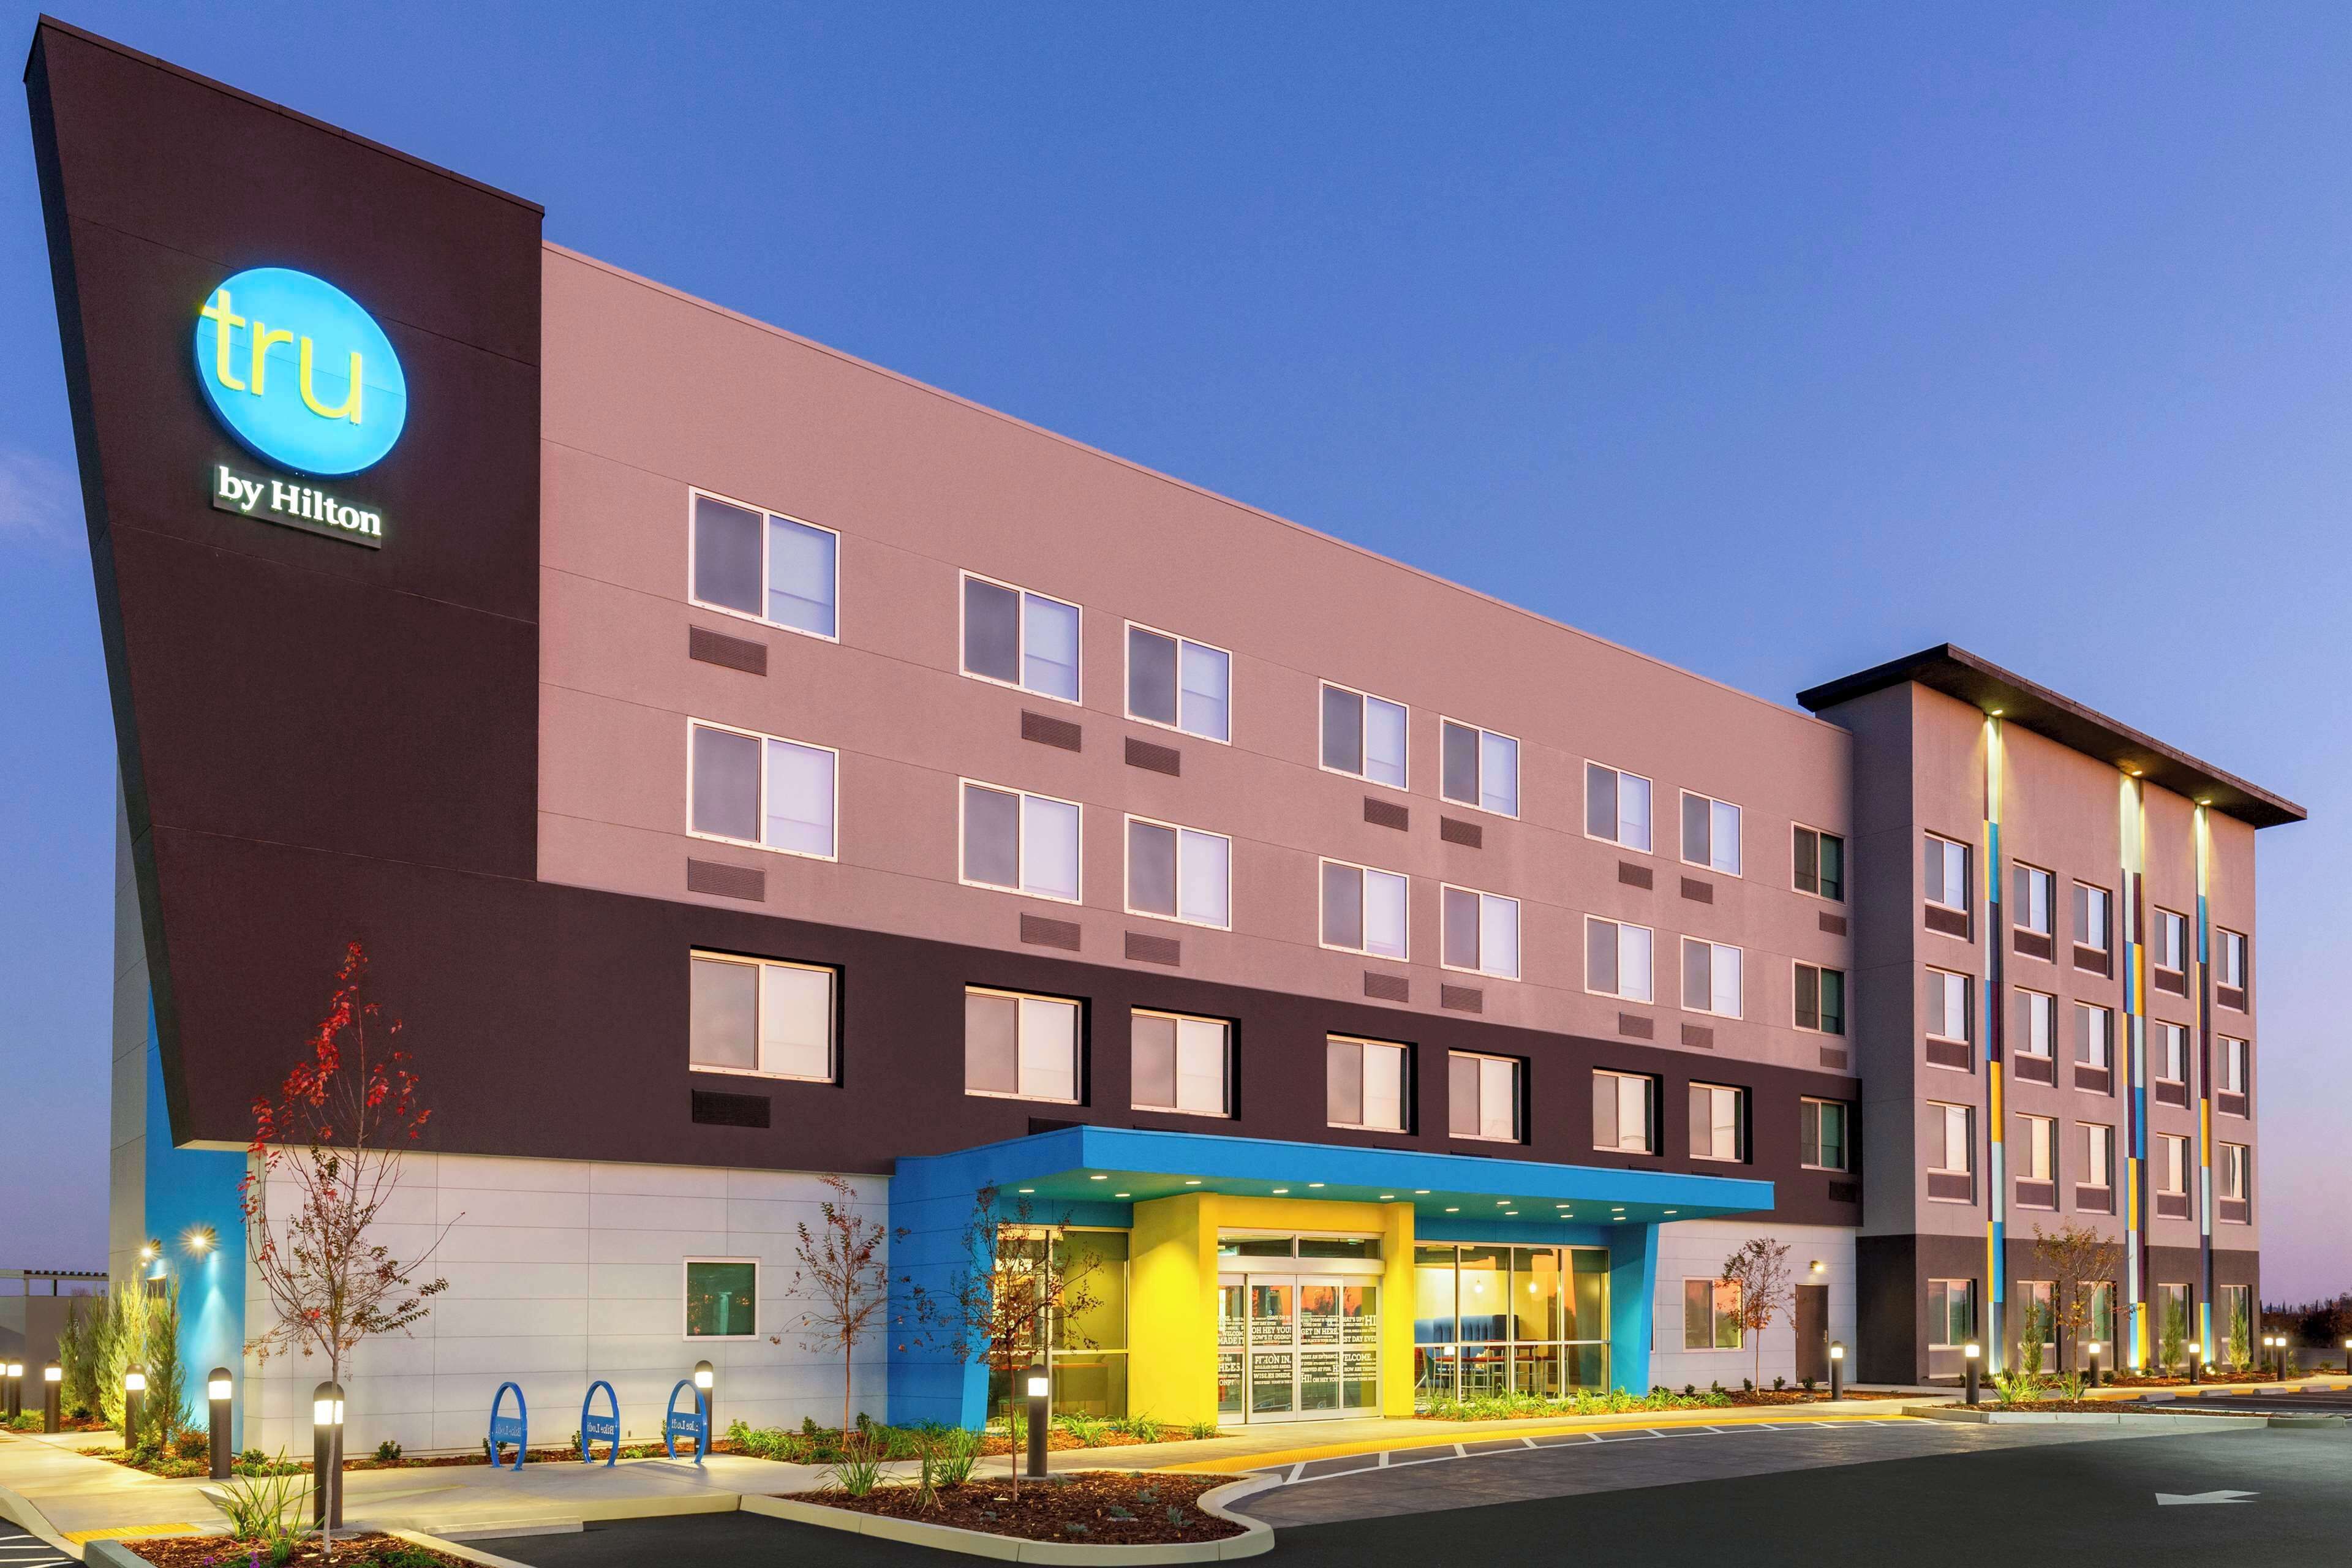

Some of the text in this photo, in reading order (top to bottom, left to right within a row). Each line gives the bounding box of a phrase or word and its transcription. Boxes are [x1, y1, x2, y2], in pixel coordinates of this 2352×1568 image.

[201, 288, 363, 426] tru
[218, 466, 382, 537] by Hilton
[1301, 1374, 1312, 1383] HI!
